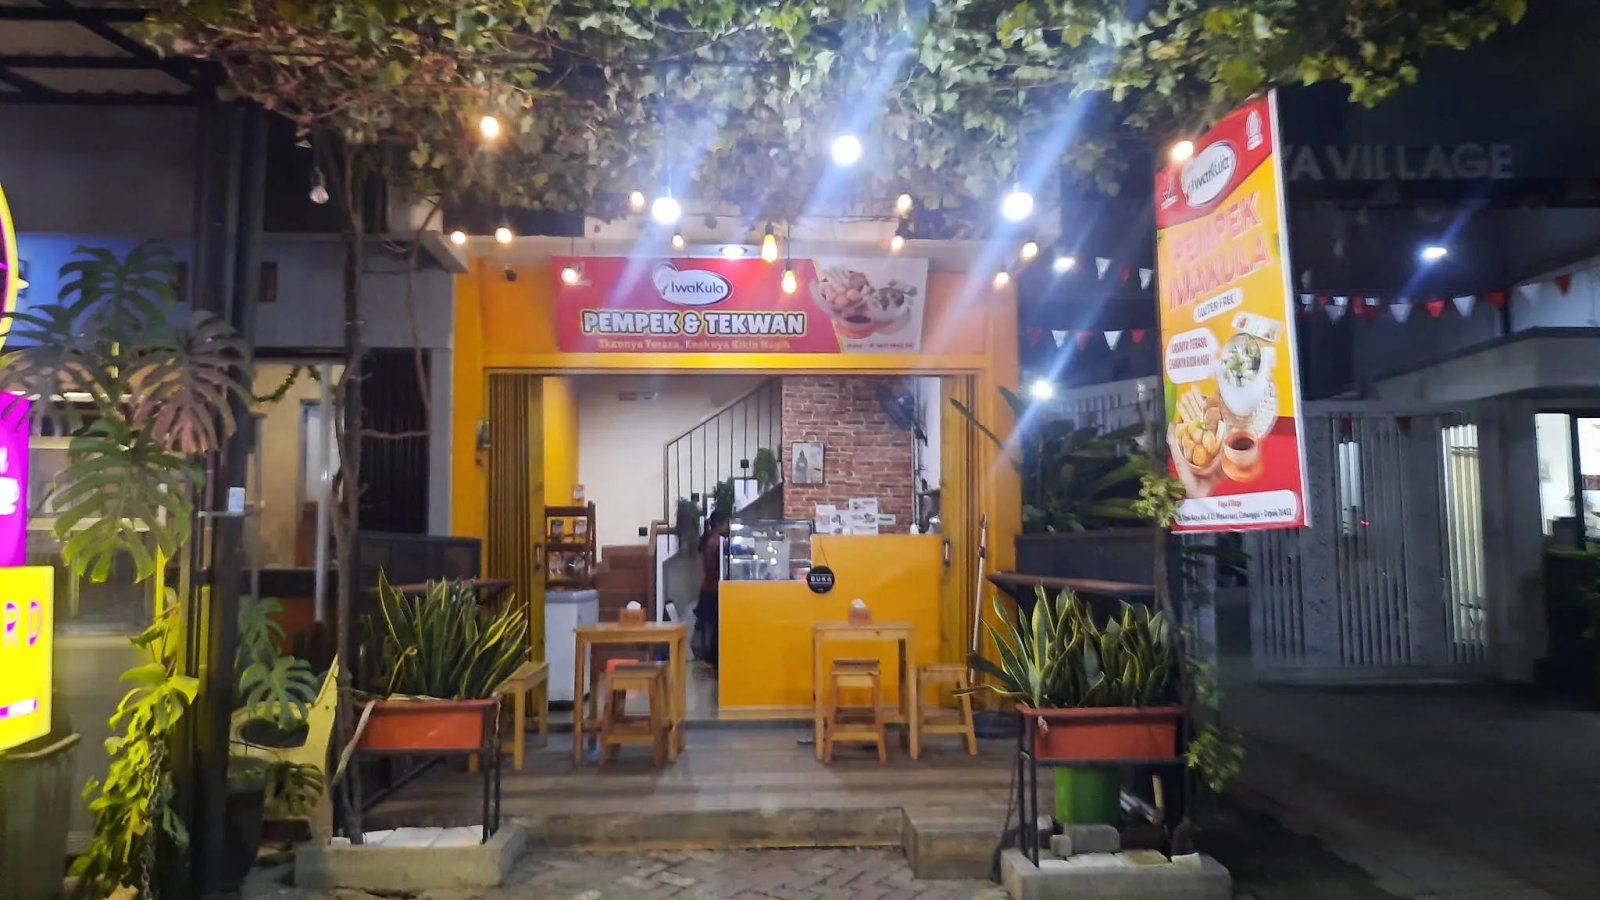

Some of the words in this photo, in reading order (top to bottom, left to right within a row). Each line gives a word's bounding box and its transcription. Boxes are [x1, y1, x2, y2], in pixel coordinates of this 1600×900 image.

[1325, 142, 1513, 180] VILLAGE
[1173, 192, 1263, 267] PEMPEK
[671, 281, 724, 295] IwaKula
[1219, 294, 1235, 310] FREE
[582, 310, 680, 334] PEMPEK
[682, 311, 701, 335] &
[704, 312, 805, 336] TEKWAN
